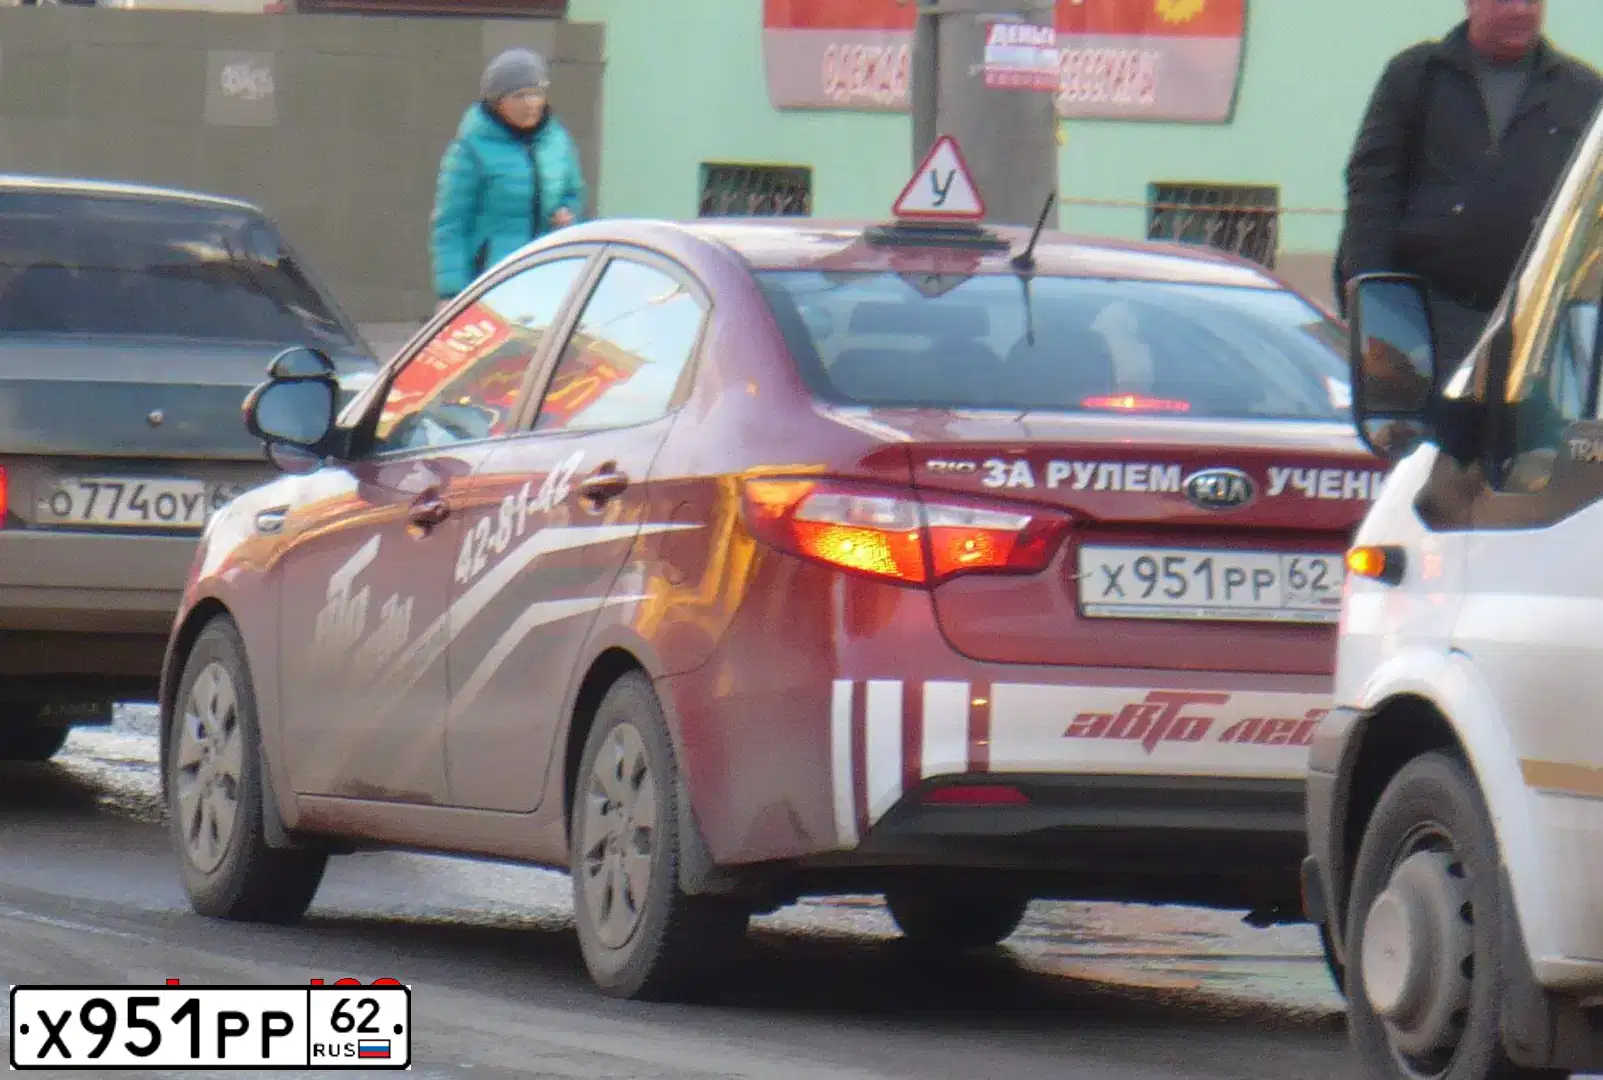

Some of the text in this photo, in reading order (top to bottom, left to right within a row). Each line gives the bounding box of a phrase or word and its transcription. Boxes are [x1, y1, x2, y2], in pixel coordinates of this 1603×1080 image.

[982, 459, 1035, 488] ЗА
[1046, 460, 1183, 493] РУЛЕМ
[1196, 474, 1247, 502] KIA
[1288, 558, 1331, 591] 62
